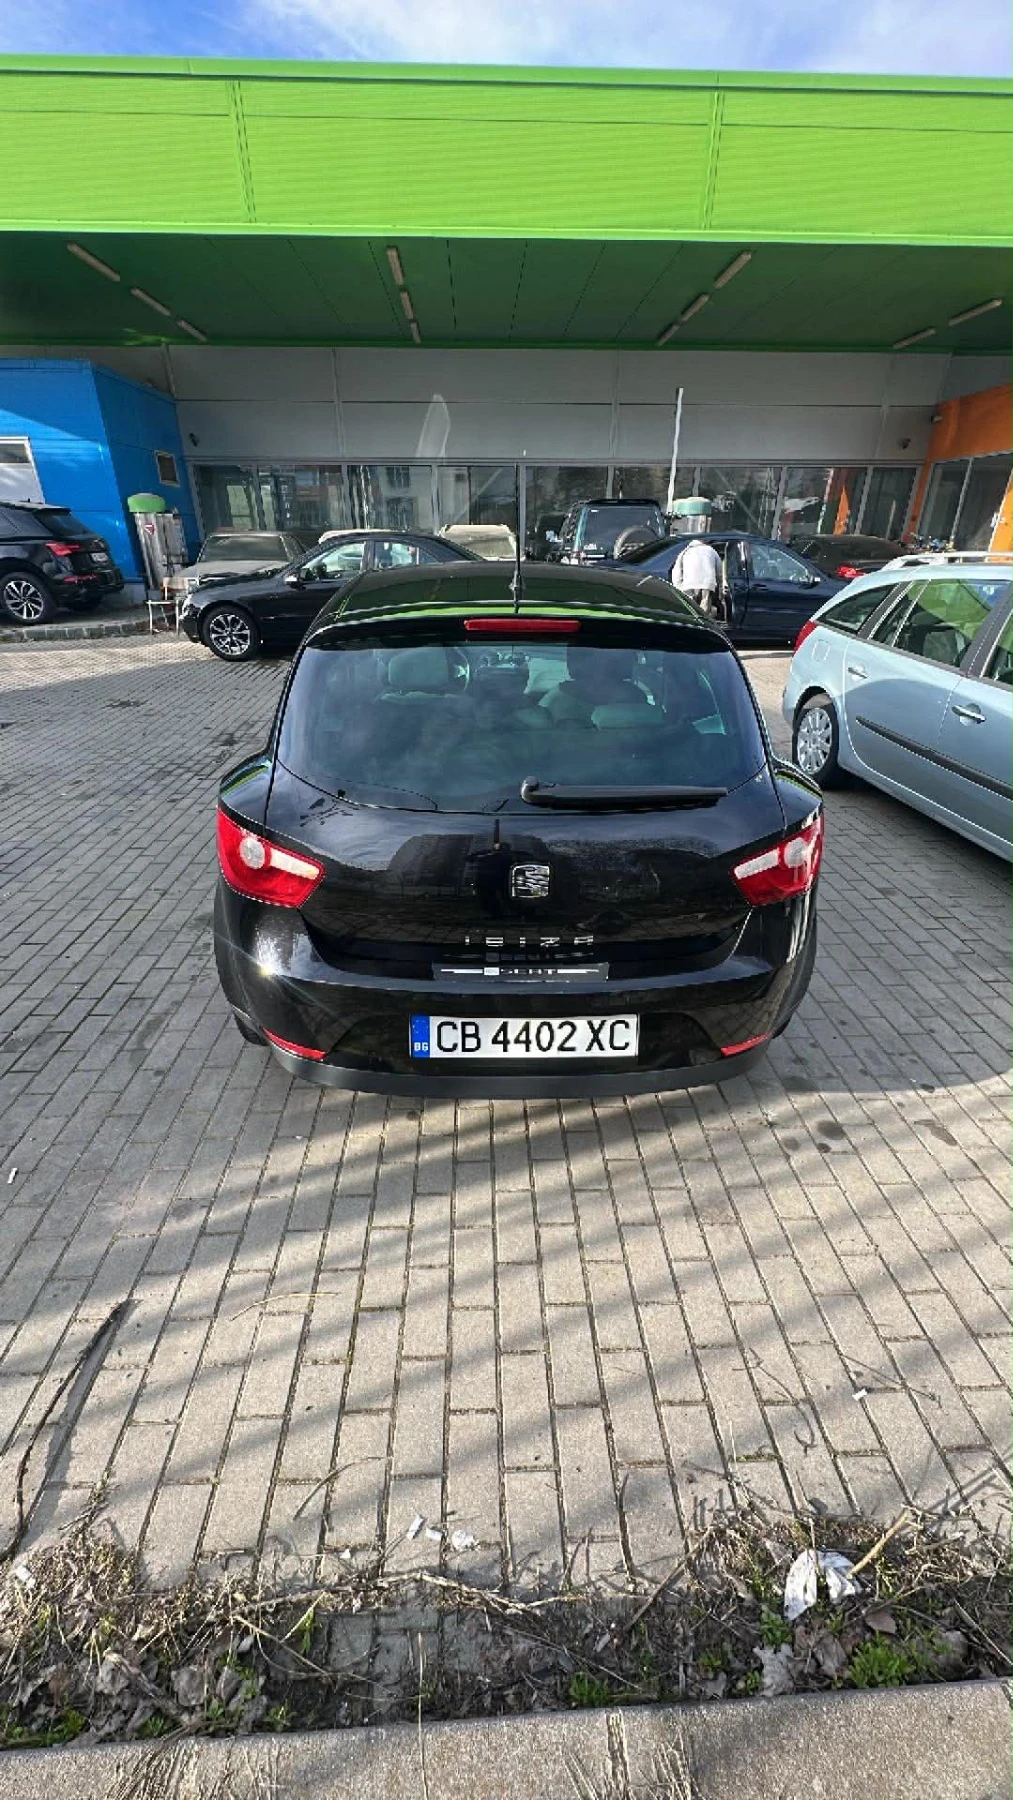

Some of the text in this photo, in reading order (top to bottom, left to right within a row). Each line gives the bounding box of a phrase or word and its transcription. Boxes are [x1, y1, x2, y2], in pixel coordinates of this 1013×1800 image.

[413, 1041, 429, 1052] BG
[436, 1019, 631, 1053] CB 4402 XC
